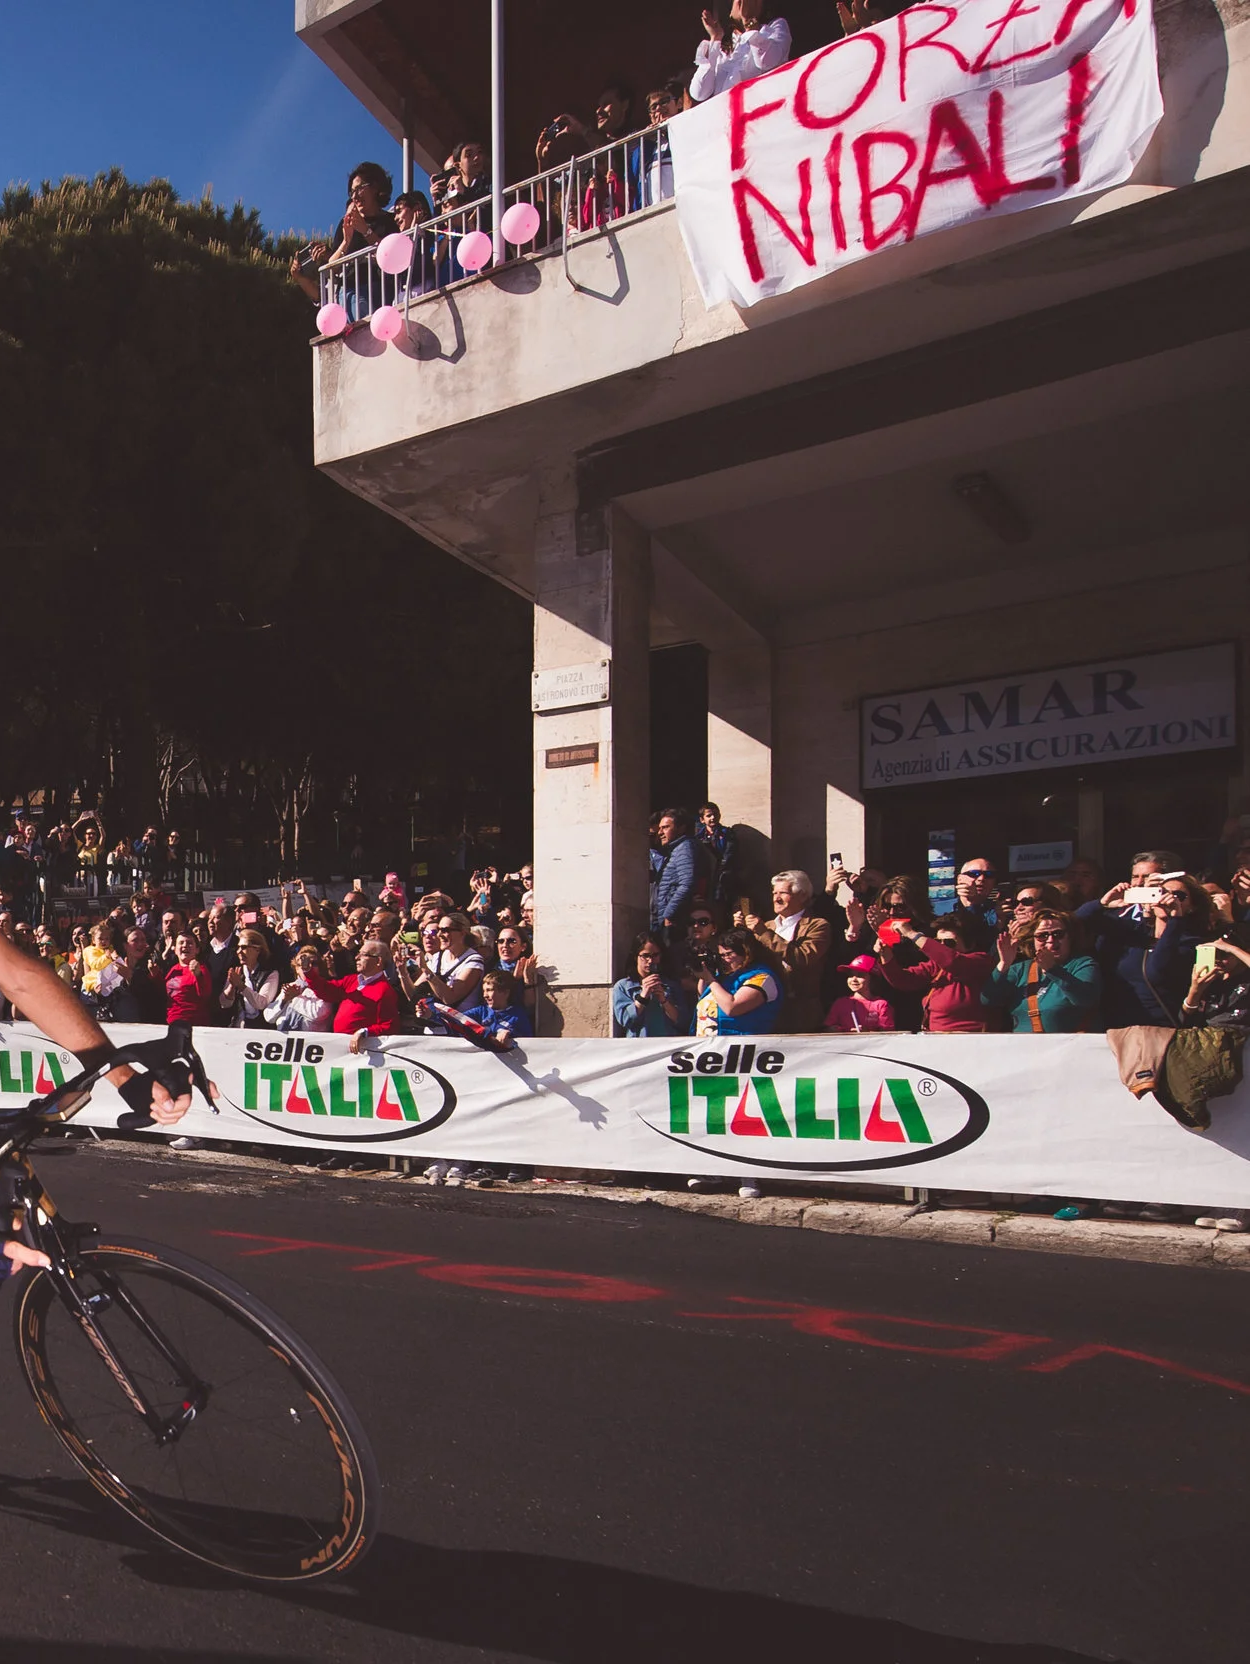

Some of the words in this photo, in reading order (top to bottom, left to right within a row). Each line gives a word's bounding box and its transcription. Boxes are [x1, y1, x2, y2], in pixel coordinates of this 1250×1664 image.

[731, 55, 1091, 282] NIBALI
[556, 672, 583, 683] PIAZZA
[870, 668, 1144, 746] SAMAR
[871, 757, 933, 783] Agenzia
[936, 750, 950, 773] di
[955, 714, 1232, 771] ASSICURAZIONI
[244, 1038, 324, 1063] selle
[667, 1043, 785, 1075] selle
